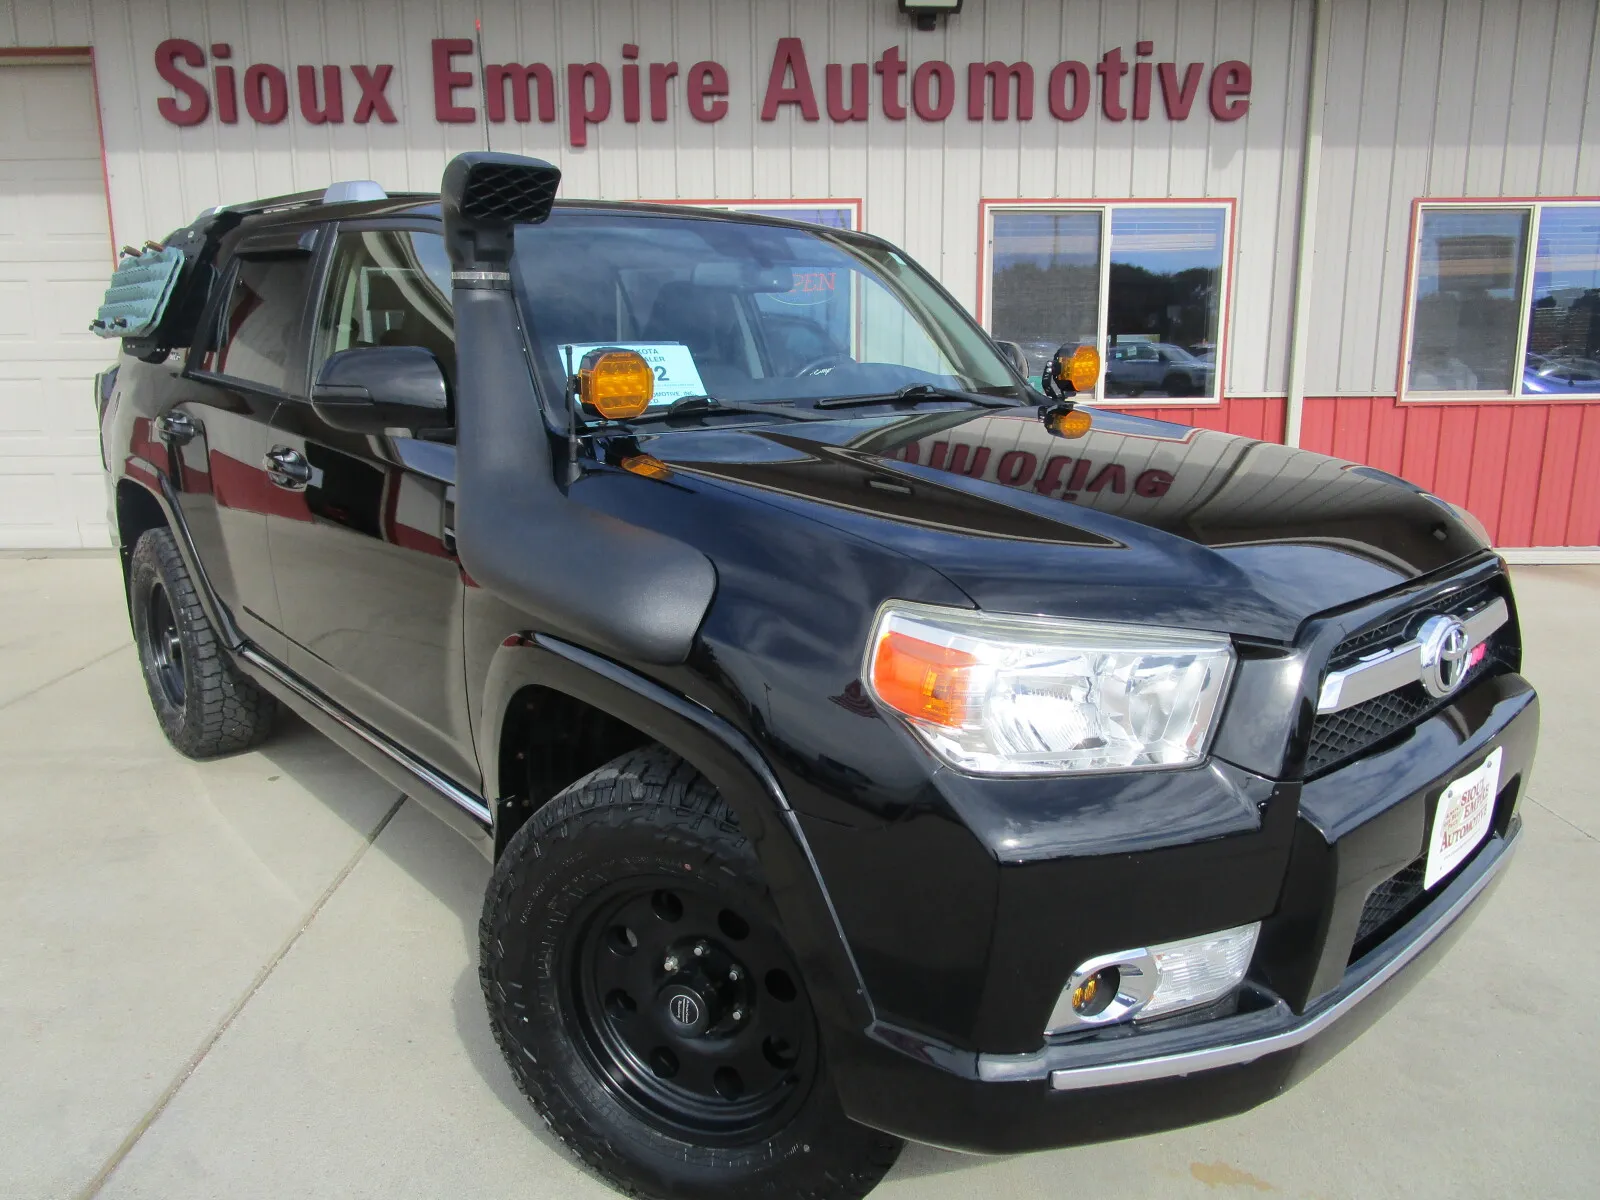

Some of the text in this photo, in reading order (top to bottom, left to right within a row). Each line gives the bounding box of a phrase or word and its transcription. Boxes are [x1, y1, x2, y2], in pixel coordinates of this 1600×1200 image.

[154, 37, 1253, 147] Sioux Empire Automotive
[788, 271, 837, 293] PEN
[653, 365, 670, 381] 2
